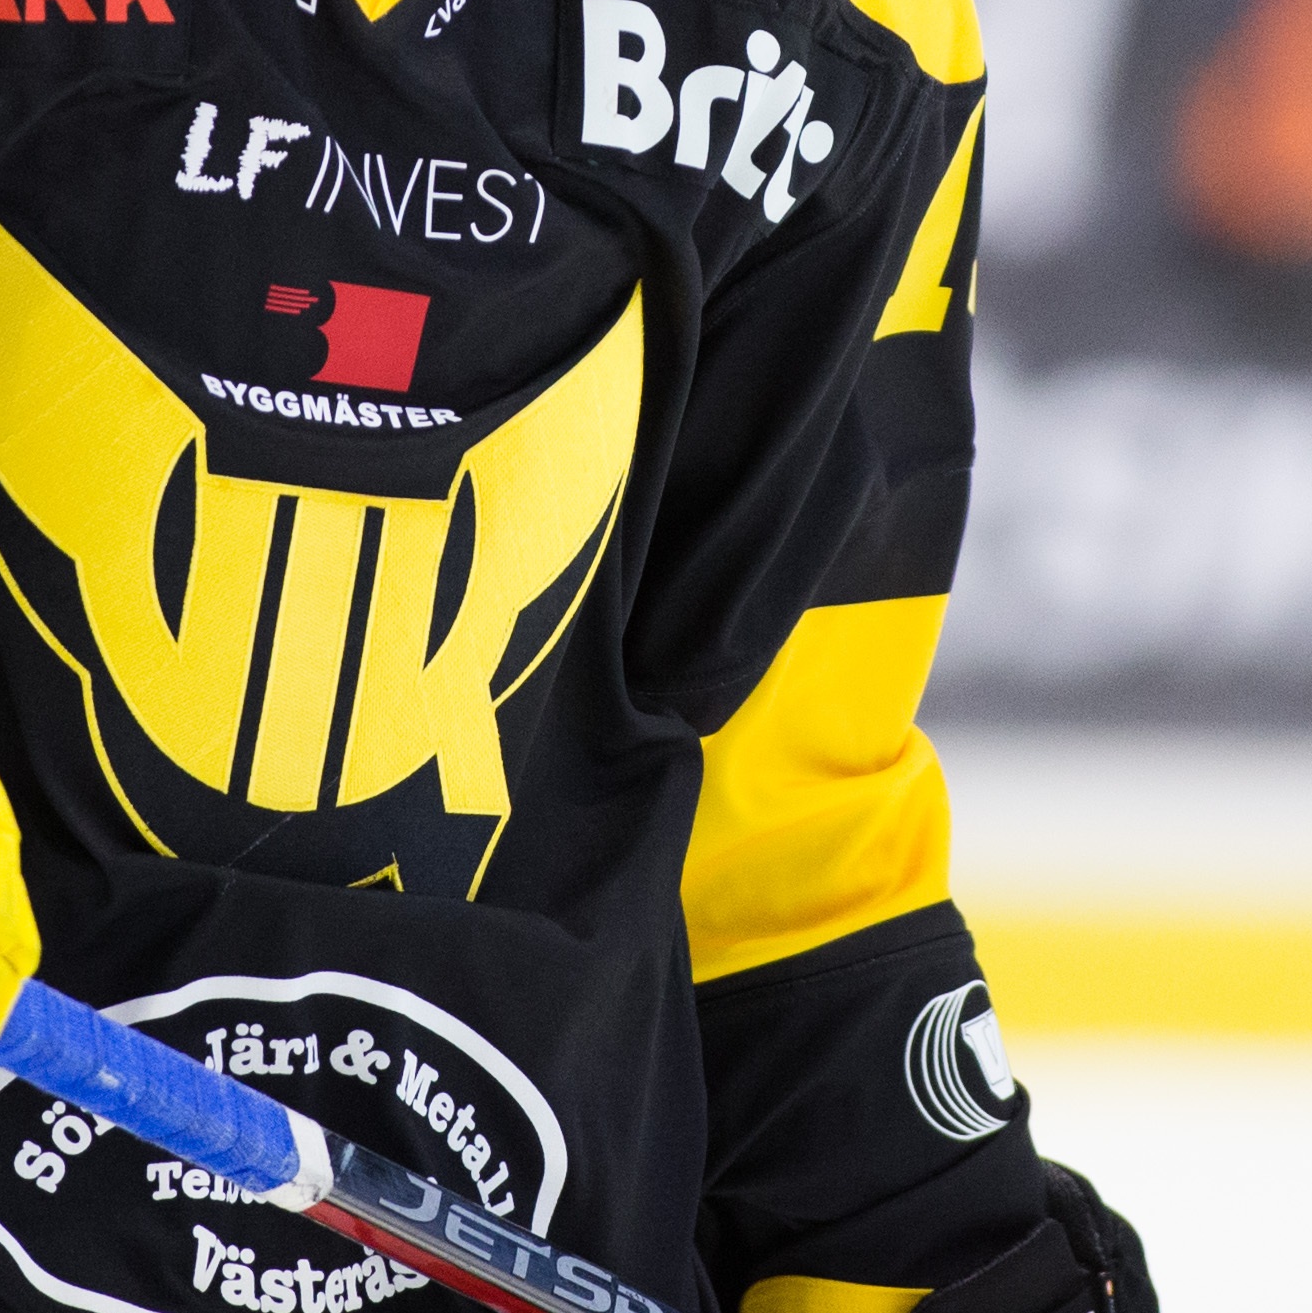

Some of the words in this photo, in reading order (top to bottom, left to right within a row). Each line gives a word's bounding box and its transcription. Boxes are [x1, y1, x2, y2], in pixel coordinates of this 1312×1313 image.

[175, 101, 311, 200] LF
[200, 372, 464, 429] BYGGMÄSTER
[329, 1029, 391, 1084] &
